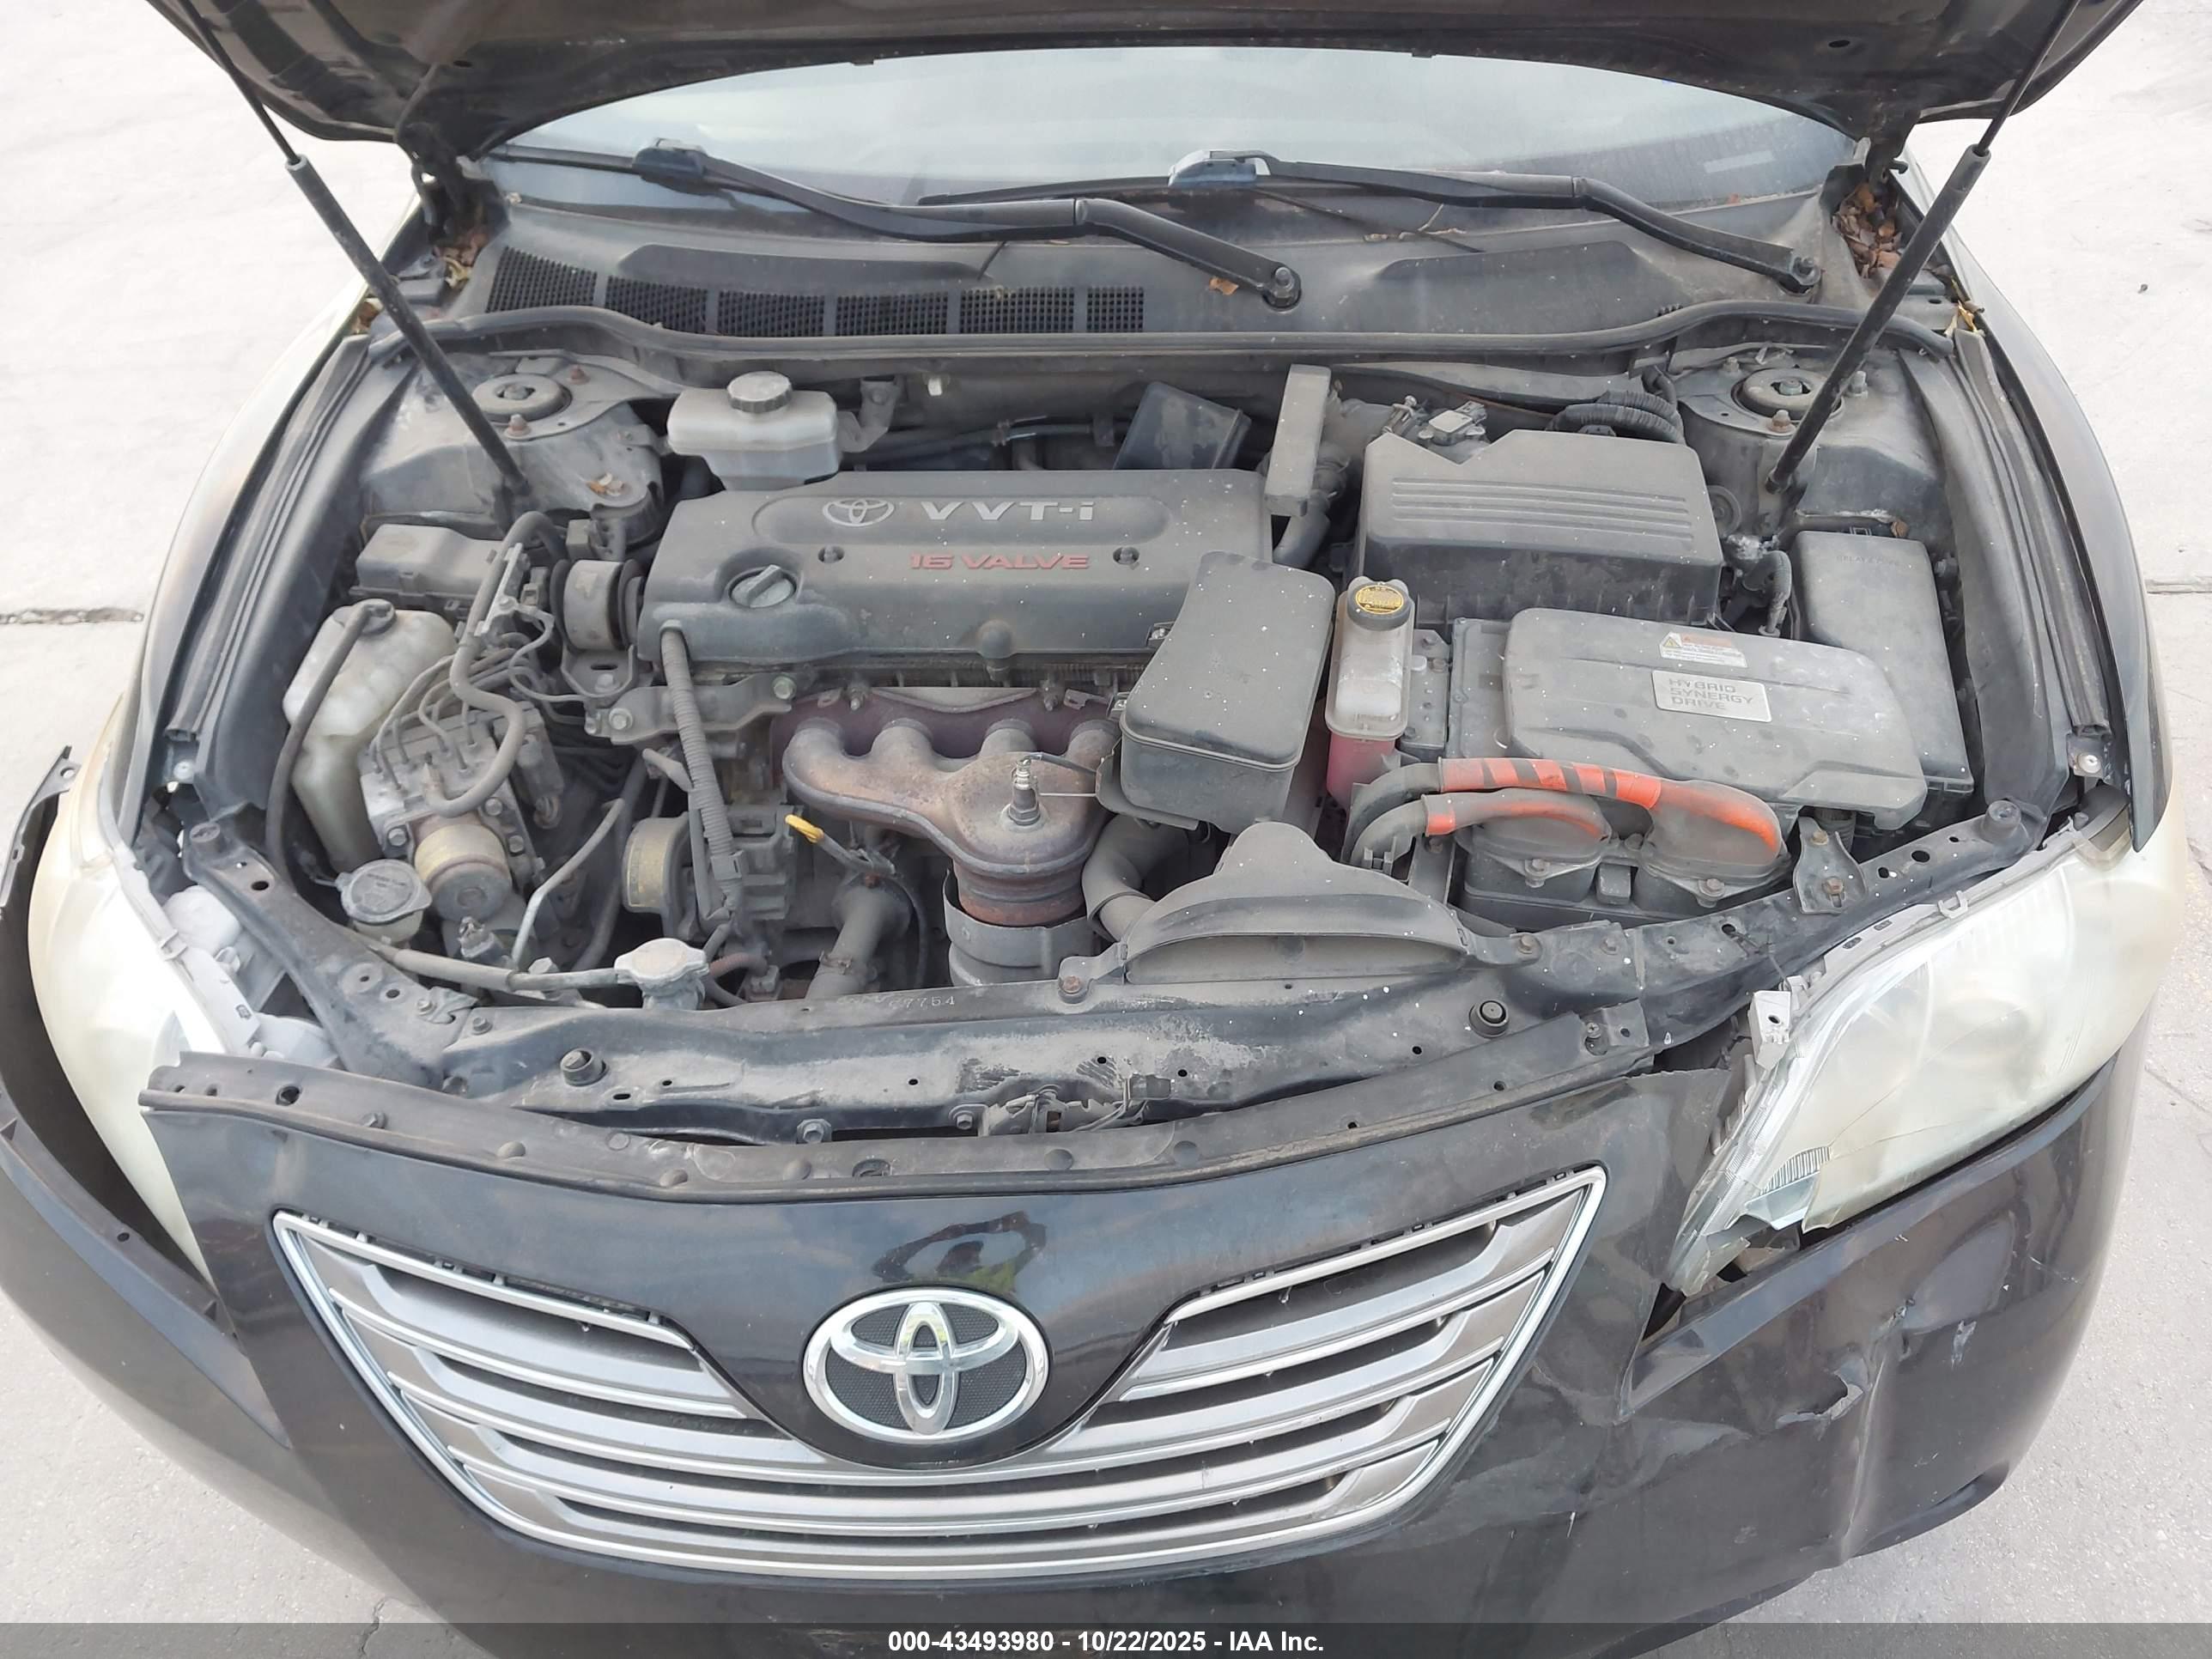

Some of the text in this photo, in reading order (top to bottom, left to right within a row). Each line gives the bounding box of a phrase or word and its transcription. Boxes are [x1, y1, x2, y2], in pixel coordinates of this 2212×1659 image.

[921, 501, 1095, 520] VVT-i
[910, 552, 1090, 569] 16 VALVE
[1668, 678, 1736, 694] HYBRID
[1669, 687, 1753, 704] SYNERGY
[1670, 696, 1726, 710] DRIVE
